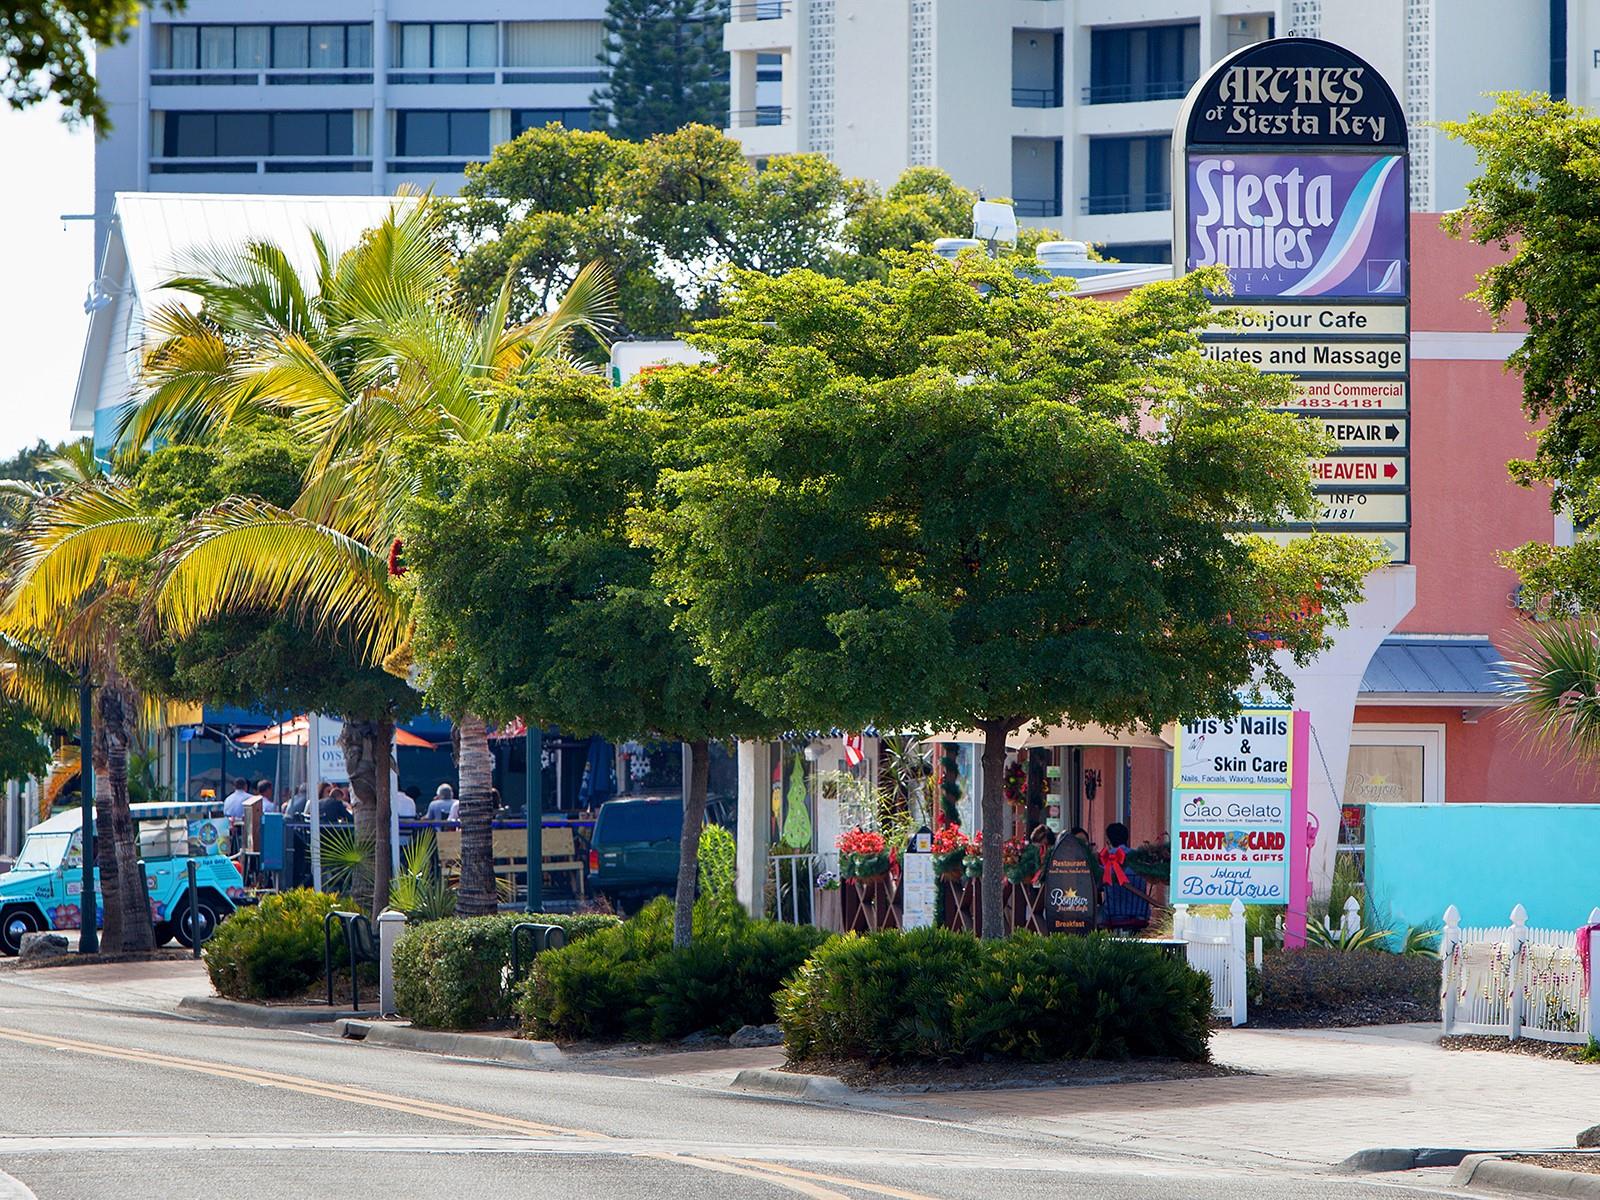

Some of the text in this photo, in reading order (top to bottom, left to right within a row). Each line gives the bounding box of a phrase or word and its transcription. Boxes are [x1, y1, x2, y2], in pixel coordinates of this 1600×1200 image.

[1219, 66, 1365, 104] ARCHES
[1206, 105, 1386, 142] of Siesta Key
[1196, 159, 1334, 228] Siesta
[1196, 217, 1314, 269] Smiles
[1228, 272, 1284, 281] NTAL
[1318, 311, 1367, 328] Cafe
[1270, 346, 1306, 364] and
[1313, 346, 1401, 368] Massage
[1309, 383, 1330, 396] and
[1333, 383, 1403, 396] Commercial
[1325, 424, 1382, 441] REPAIR
[1312, 463, 1377, 479] HEAVEN
[1330, 494, 1367, 505] INFO
[1240, 716, 1288, 735] Nails
[1240, 739, 1251, 754] &
[1214, 756, 1288, 773] Skin Care
[1257, 775, 1288, 784] Massage
[1184, 803, 1282, 817] Ciao Gelato
[1179, 831, 1286, 851] TAROT CARD
[1180, 853, 1284, 862] READINGS & GIFTS
[1210, 867, 1252, 879] Island
[1182, 876, 1281, 898] Boutique
[1055, 920, 1085, 928] Breakfast
